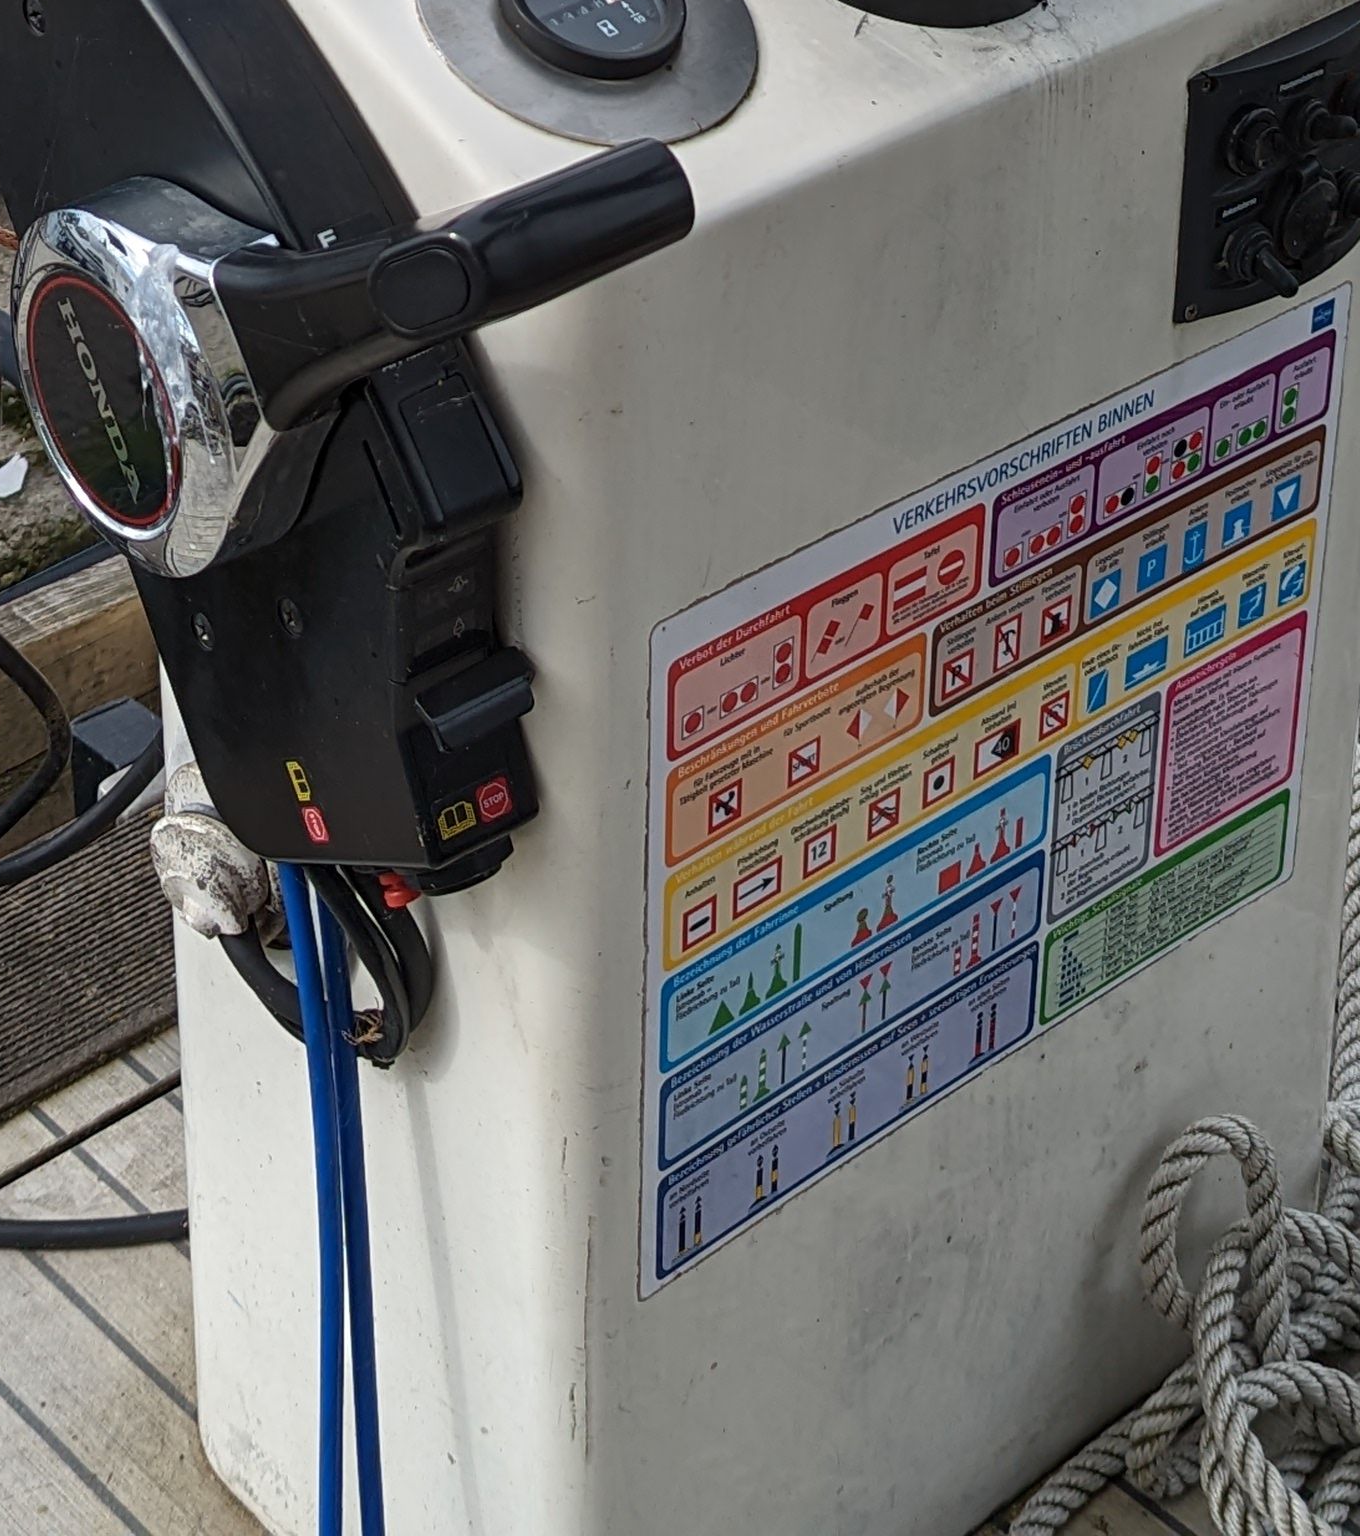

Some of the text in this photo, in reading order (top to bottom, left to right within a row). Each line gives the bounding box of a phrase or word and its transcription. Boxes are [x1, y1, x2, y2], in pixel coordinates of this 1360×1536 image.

[57, 297, 140, 505] HONDA
[893, 388, 1155, 536] VERKEHRSVORSCHRIFTEN BINNEN
[1000, 433, 1126, 505] Schleusenein- und -ausfahrt
[1145, 557, 1157, 579] P
[678, 602, 791, 671] Verbot der Durchfahrt
[677, 680, 839, 780] Beschränkungen und Fahrverbote
[994, 734, 1010, 757] 40
[482, 791, 505, 809] STOP
[810, 837, 828, 863] 12
[673, 903, 799, 990] Bezeichnung der Fahrrinne
[671, 929, 912, 1090] Bezeichnung der Wasserstraße und von Hindernissen
